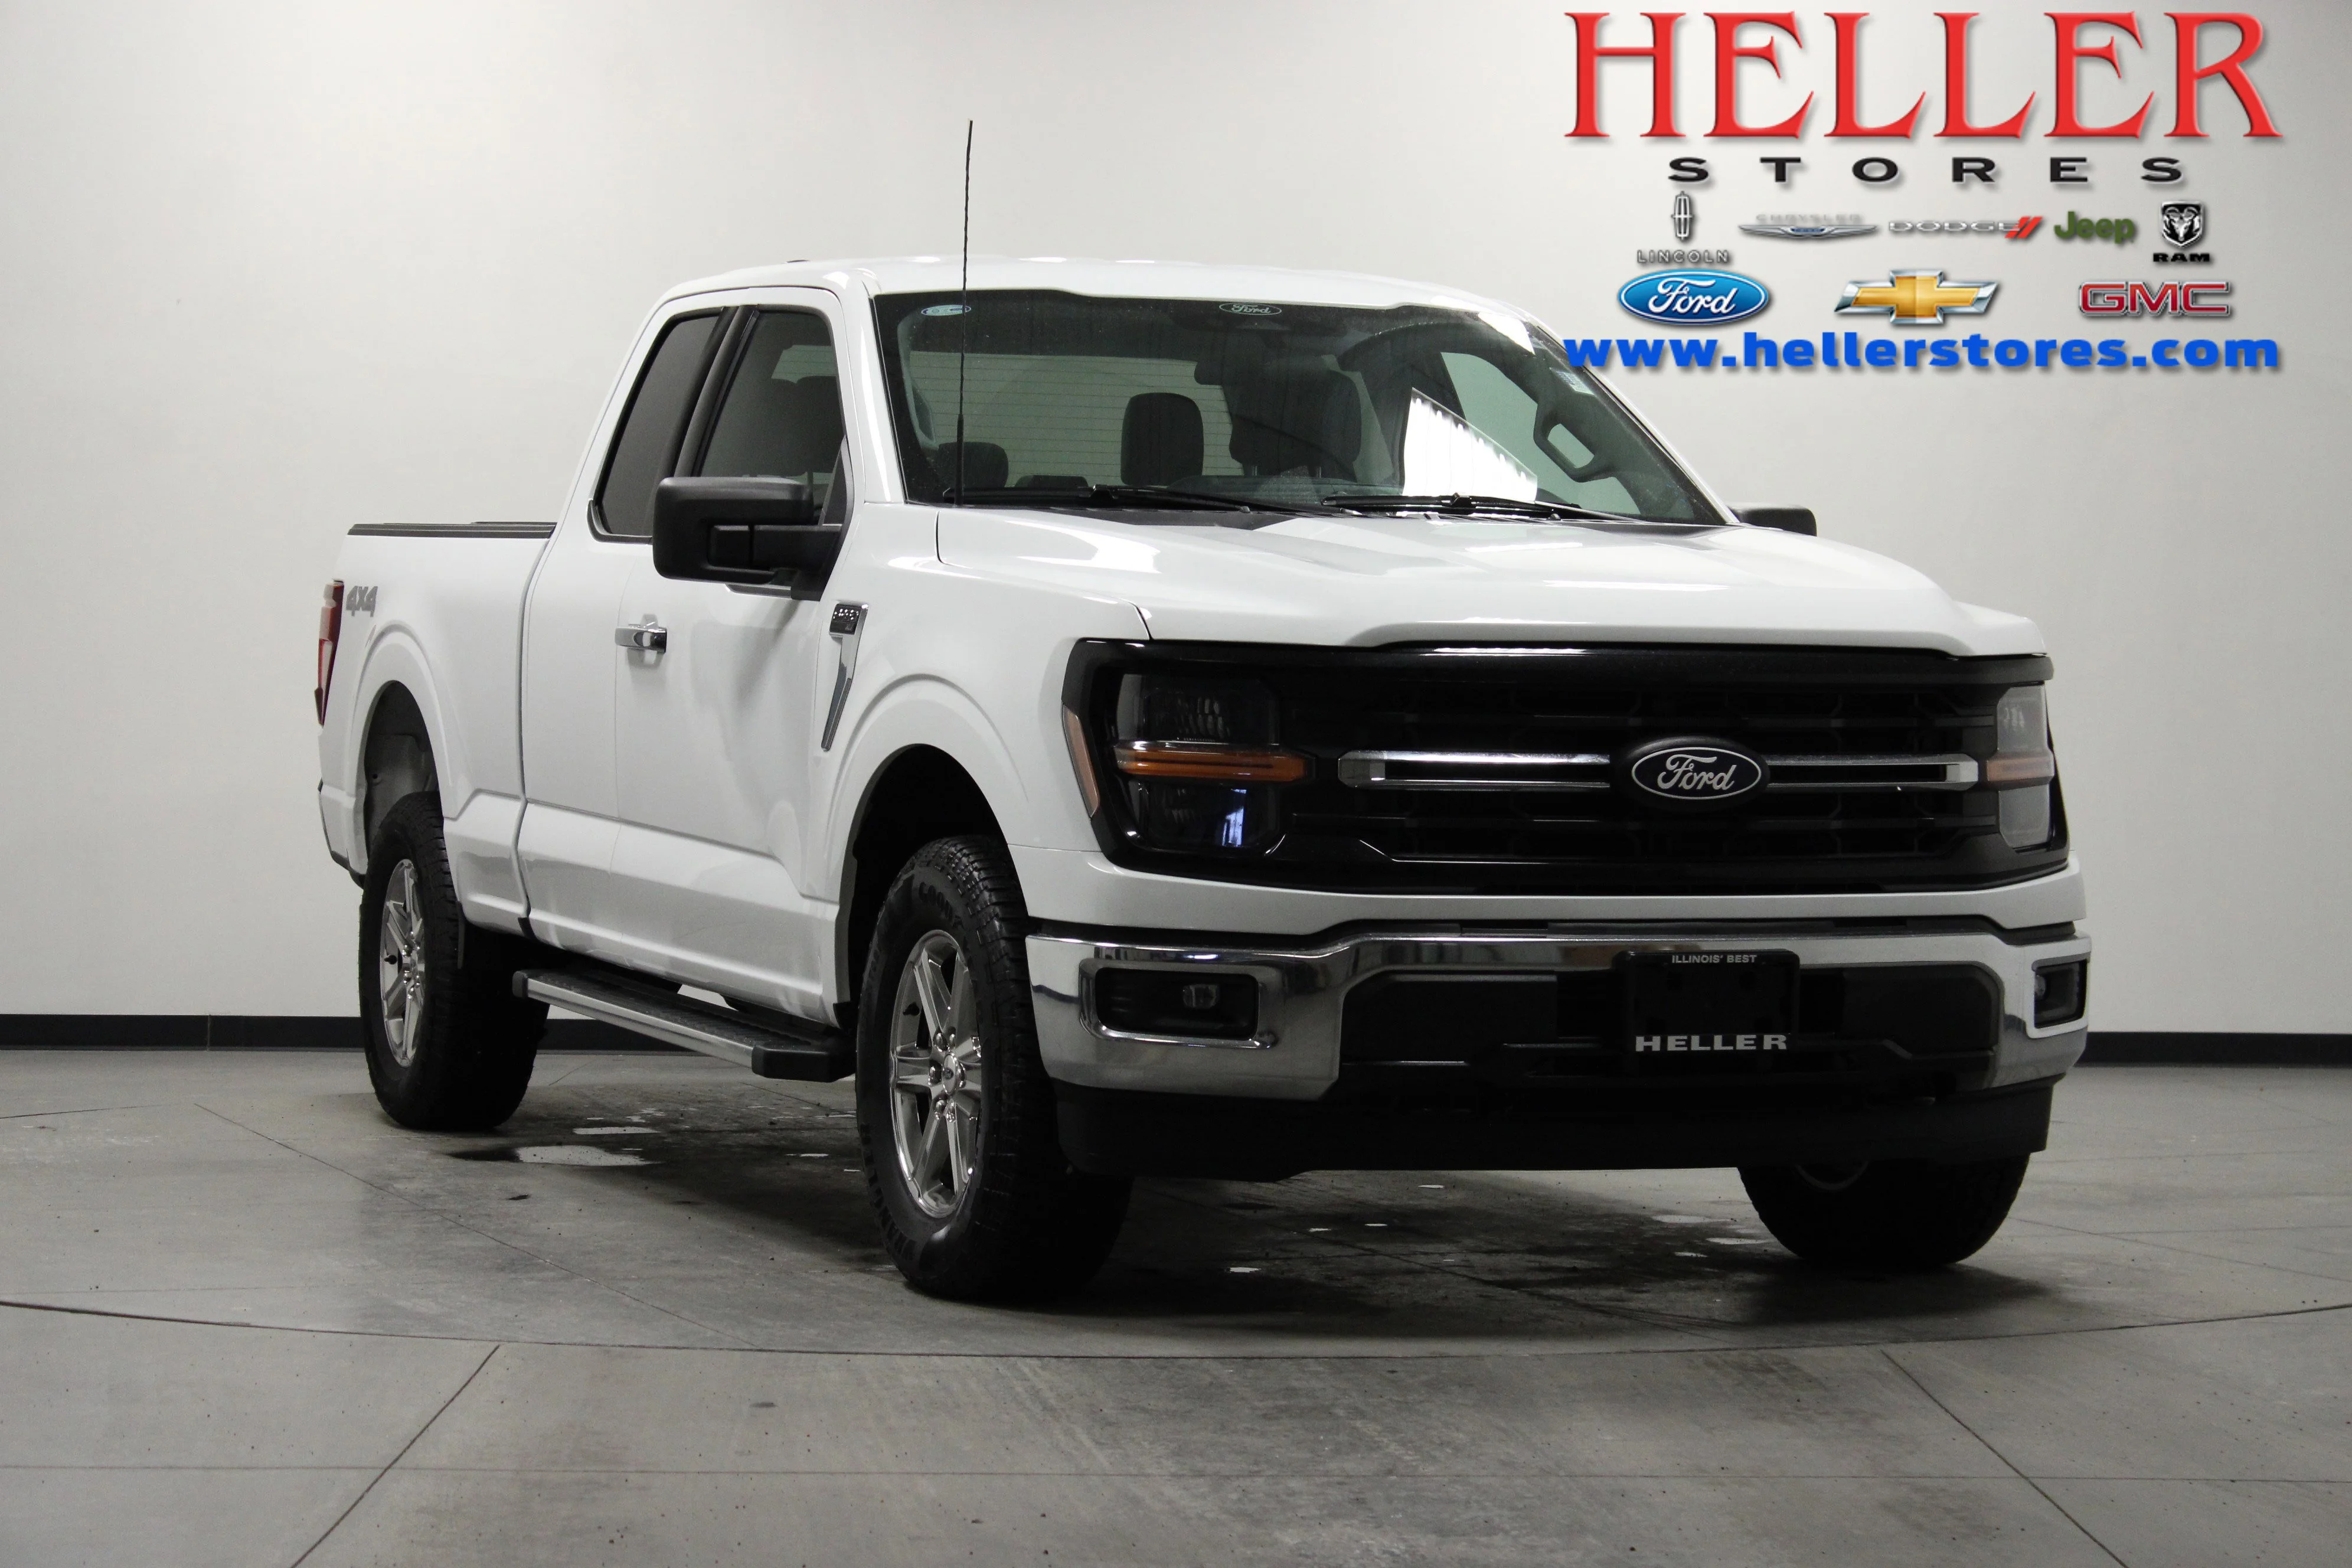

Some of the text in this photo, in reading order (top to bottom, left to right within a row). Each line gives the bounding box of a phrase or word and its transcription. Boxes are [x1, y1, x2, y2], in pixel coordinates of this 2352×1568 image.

[1231, 303, 1271, 313] Ford
[1657, 754, 1737, 790] Ford
[1727, 954, 1757, 963] BEST
[1635, 1034, 1787, 1051] HELLER
